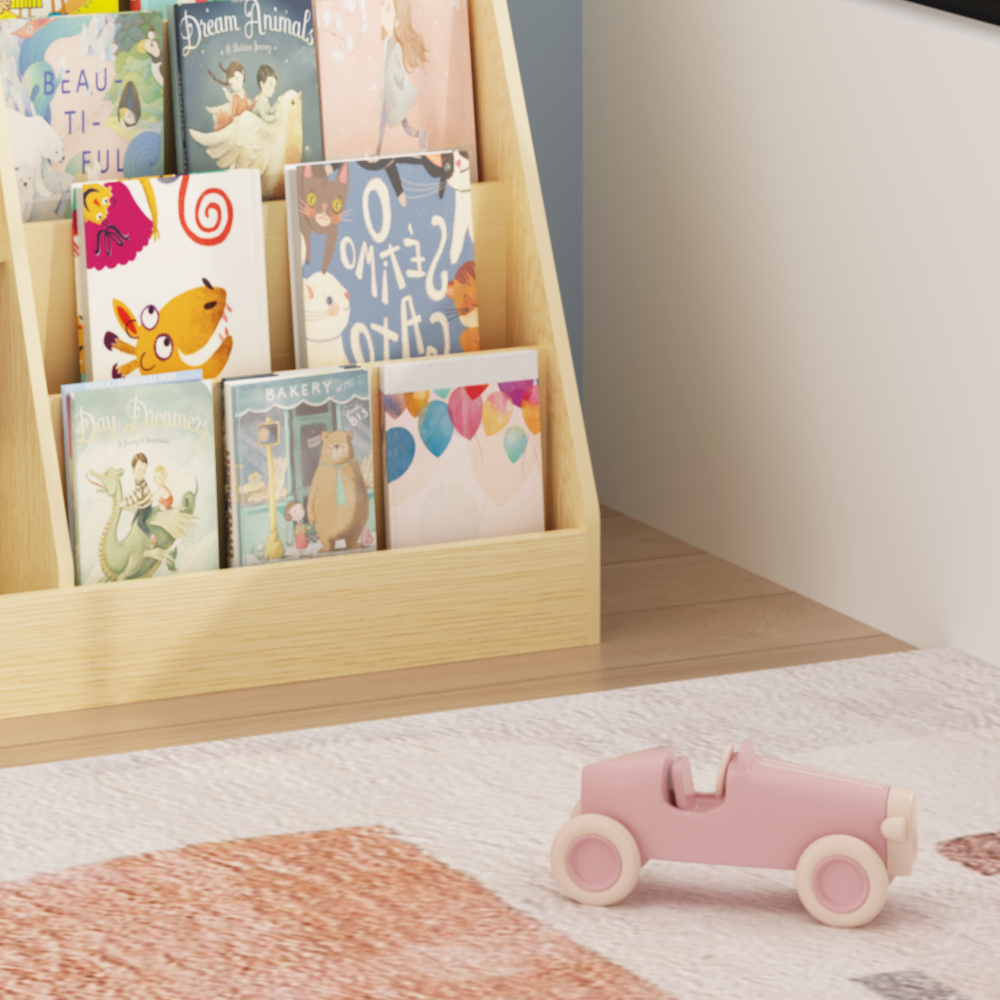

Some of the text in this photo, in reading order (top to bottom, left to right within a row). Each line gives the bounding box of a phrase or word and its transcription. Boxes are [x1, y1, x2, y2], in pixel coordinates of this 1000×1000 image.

[179, 9, 241, 57] Dream
[44, 68, 122, 95] BEAU-
[64, 110, 100, 134] TI-
[81, 149, 124, 174] FUL
[265, 380, 332, 402] BAKERY
[73, 392, 209, 449] Day Dreamers
